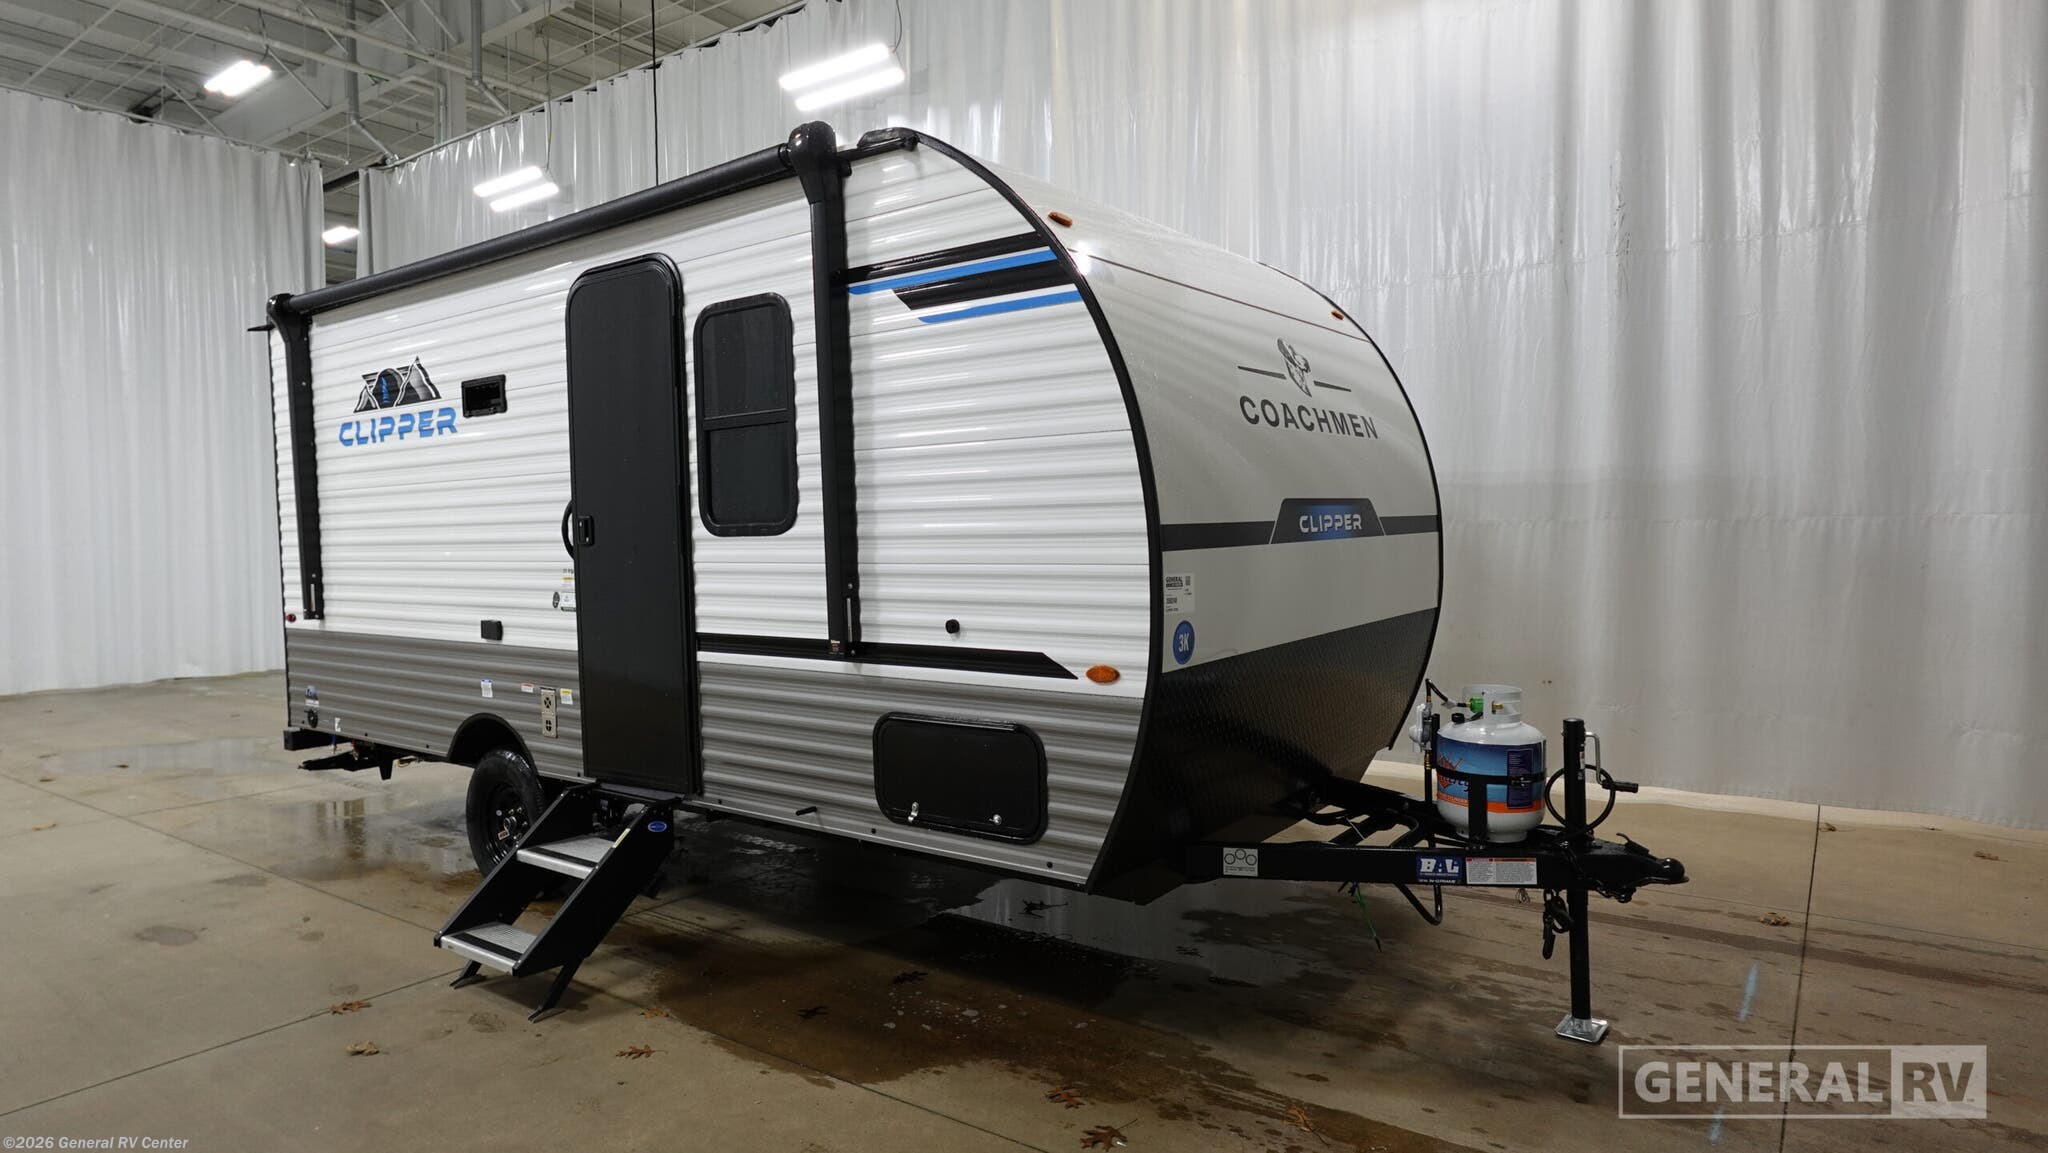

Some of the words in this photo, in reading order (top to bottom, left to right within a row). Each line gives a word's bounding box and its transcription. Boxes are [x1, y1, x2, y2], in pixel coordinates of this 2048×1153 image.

[338, 407, 457, 447] CLIPPER
[1239, 395, 1379, 439] COACHMEN
[1299, 513, 1363, 534] CLIPPER
[1178, 632, 1189, 652] 3K
